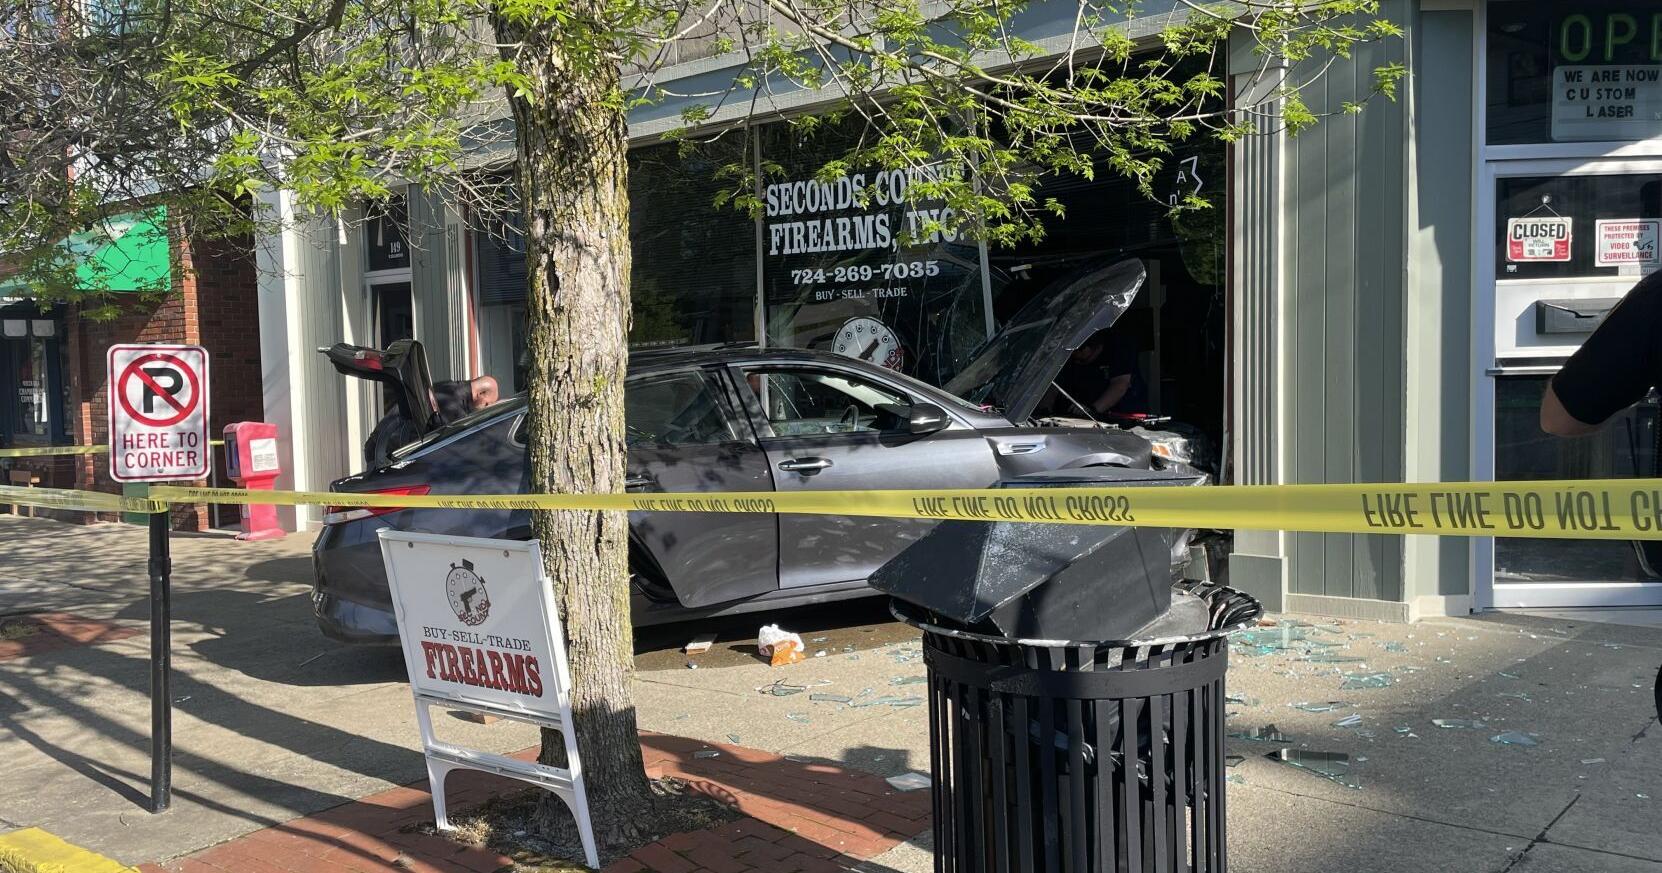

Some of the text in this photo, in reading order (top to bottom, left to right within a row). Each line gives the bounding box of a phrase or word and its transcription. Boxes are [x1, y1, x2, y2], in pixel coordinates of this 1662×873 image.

[1564, 69, 1659, 83] WE ARE NOW
[766, 173, 867, 217] SECONDS
[769, 206, 966, 256] FIREARMS, INC.
[1513, 223, 1566, 240] CLOSED
[1604, 232, 1635, 240] PROTECTED
[1610, 242, 1630, 250] VIDEO
[1603, 251, 1653, 260] SURVEILLANCE
[791, 260, 940, 285] 724-269-7035
[815, 289, 835, 301] BUY
[841, 289, 865, 299] SELL
[872, 287, 908, 298] TRADE
[123, 431, 198, 450] HERE TO
[124, 450, 198, 468] CORNER
[423, 626, 532, 652] BUY-SELL-TRADE
[420, 640, 544, 699] FIREARMS
